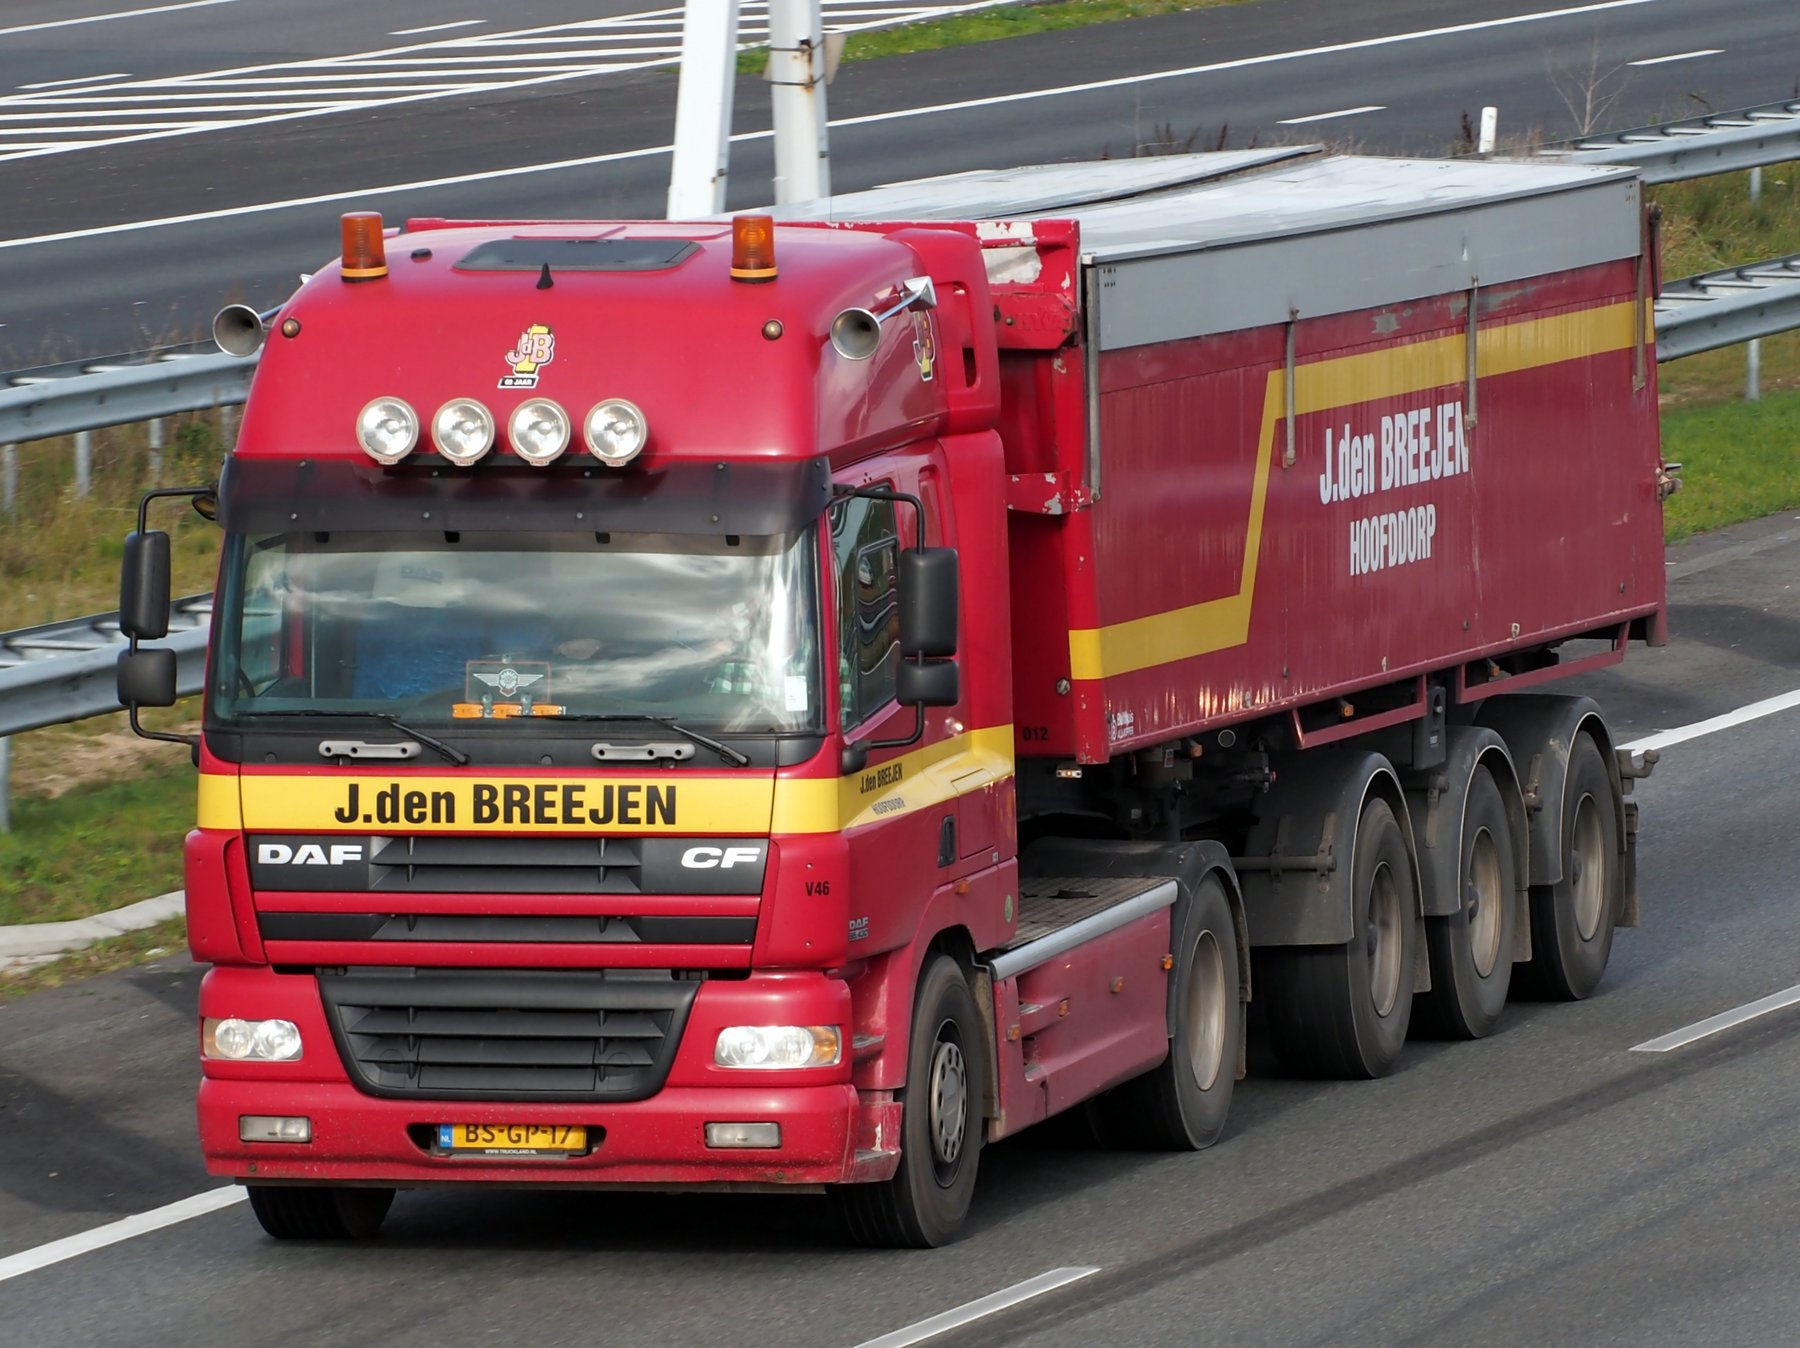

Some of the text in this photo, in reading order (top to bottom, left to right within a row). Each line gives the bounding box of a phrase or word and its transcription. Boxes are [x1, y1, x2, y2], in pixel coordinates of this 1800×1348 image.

[1319, 401, 1469, 505] J.den BREEJEN
[1350, 503, 1436, 576] HOOFDDORP
[860, 763, 903, 794] J.den BREEJEN
[334, 782, 676, 825] J.den BREEJEN
[257, 844, 363, 865] DAF
[680, 847, 761, 869] CF
[805, 881, 830, 896] V46
[849, 916, 869, 930] DAF
[441, 1135, 451, 1143] NL
